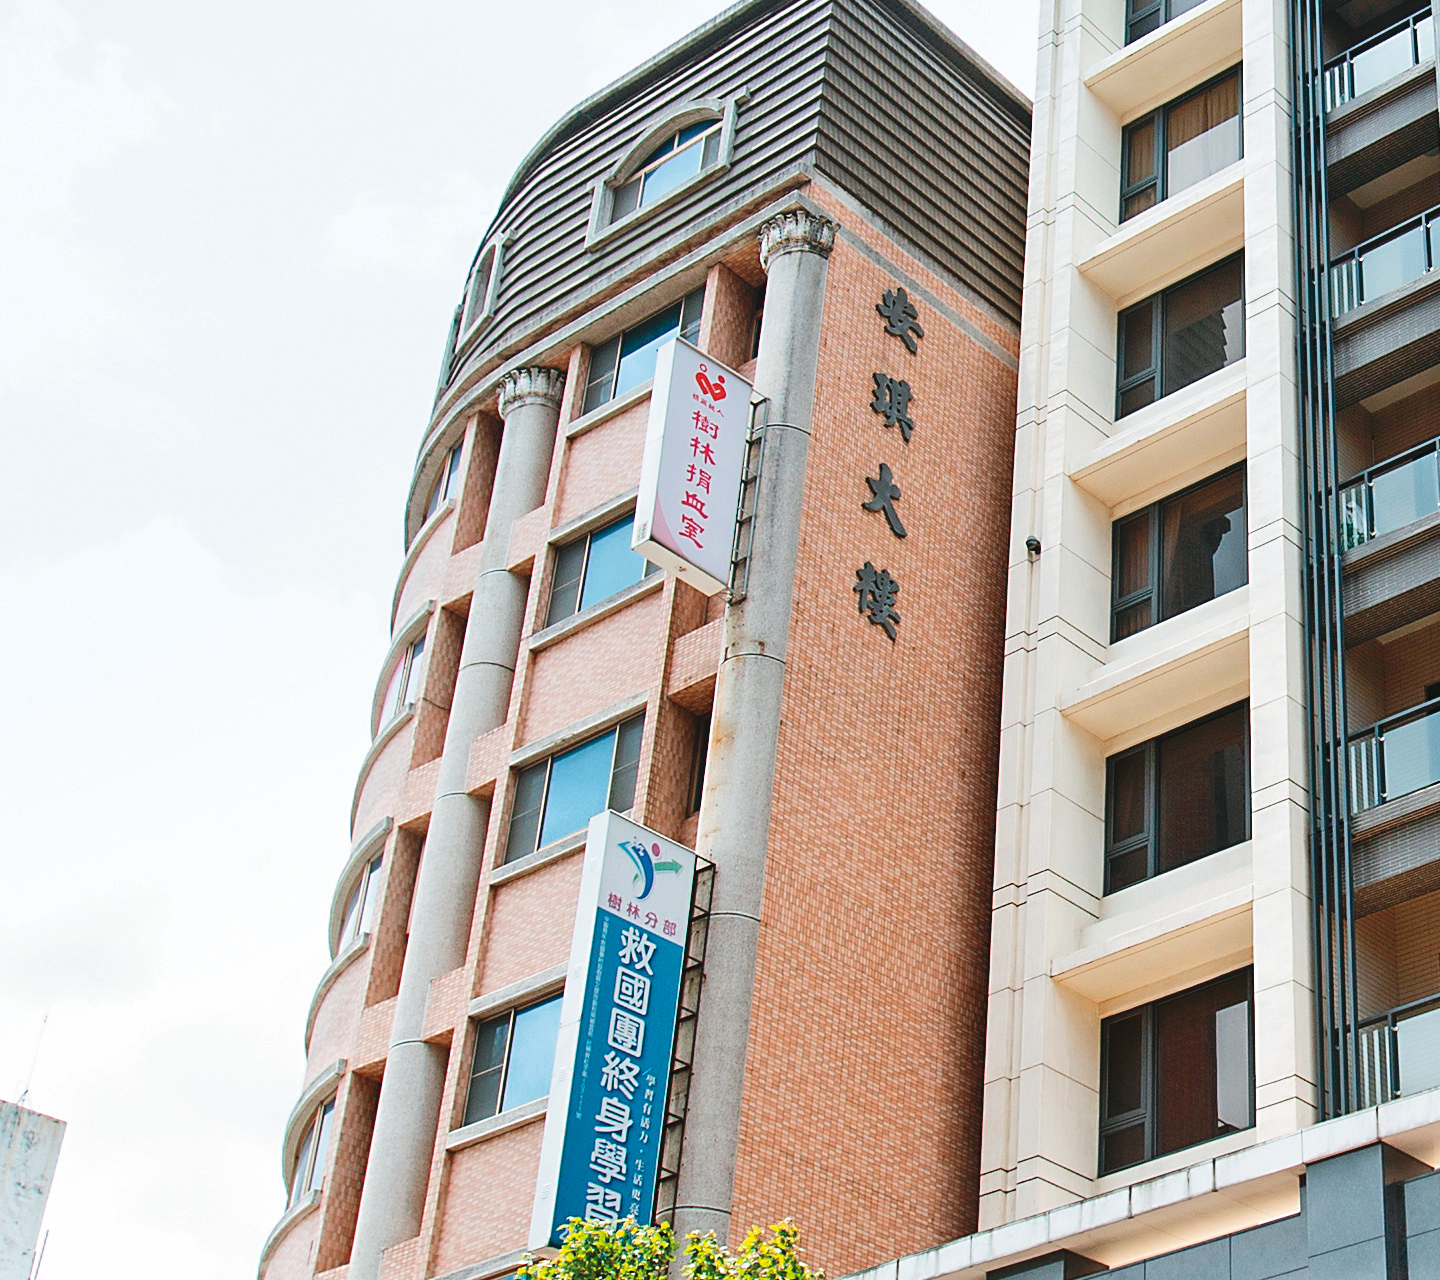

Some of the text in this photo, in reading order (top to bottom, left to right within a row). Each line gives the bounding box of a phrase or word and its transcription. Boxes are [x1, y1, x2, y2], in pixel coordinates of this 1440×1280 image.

[678, 410, 720, 549] 樹林捐血室
[608, 892, 677, 937] 樹林分部
[585, 926, 658, 1234] 救國團終身學習
